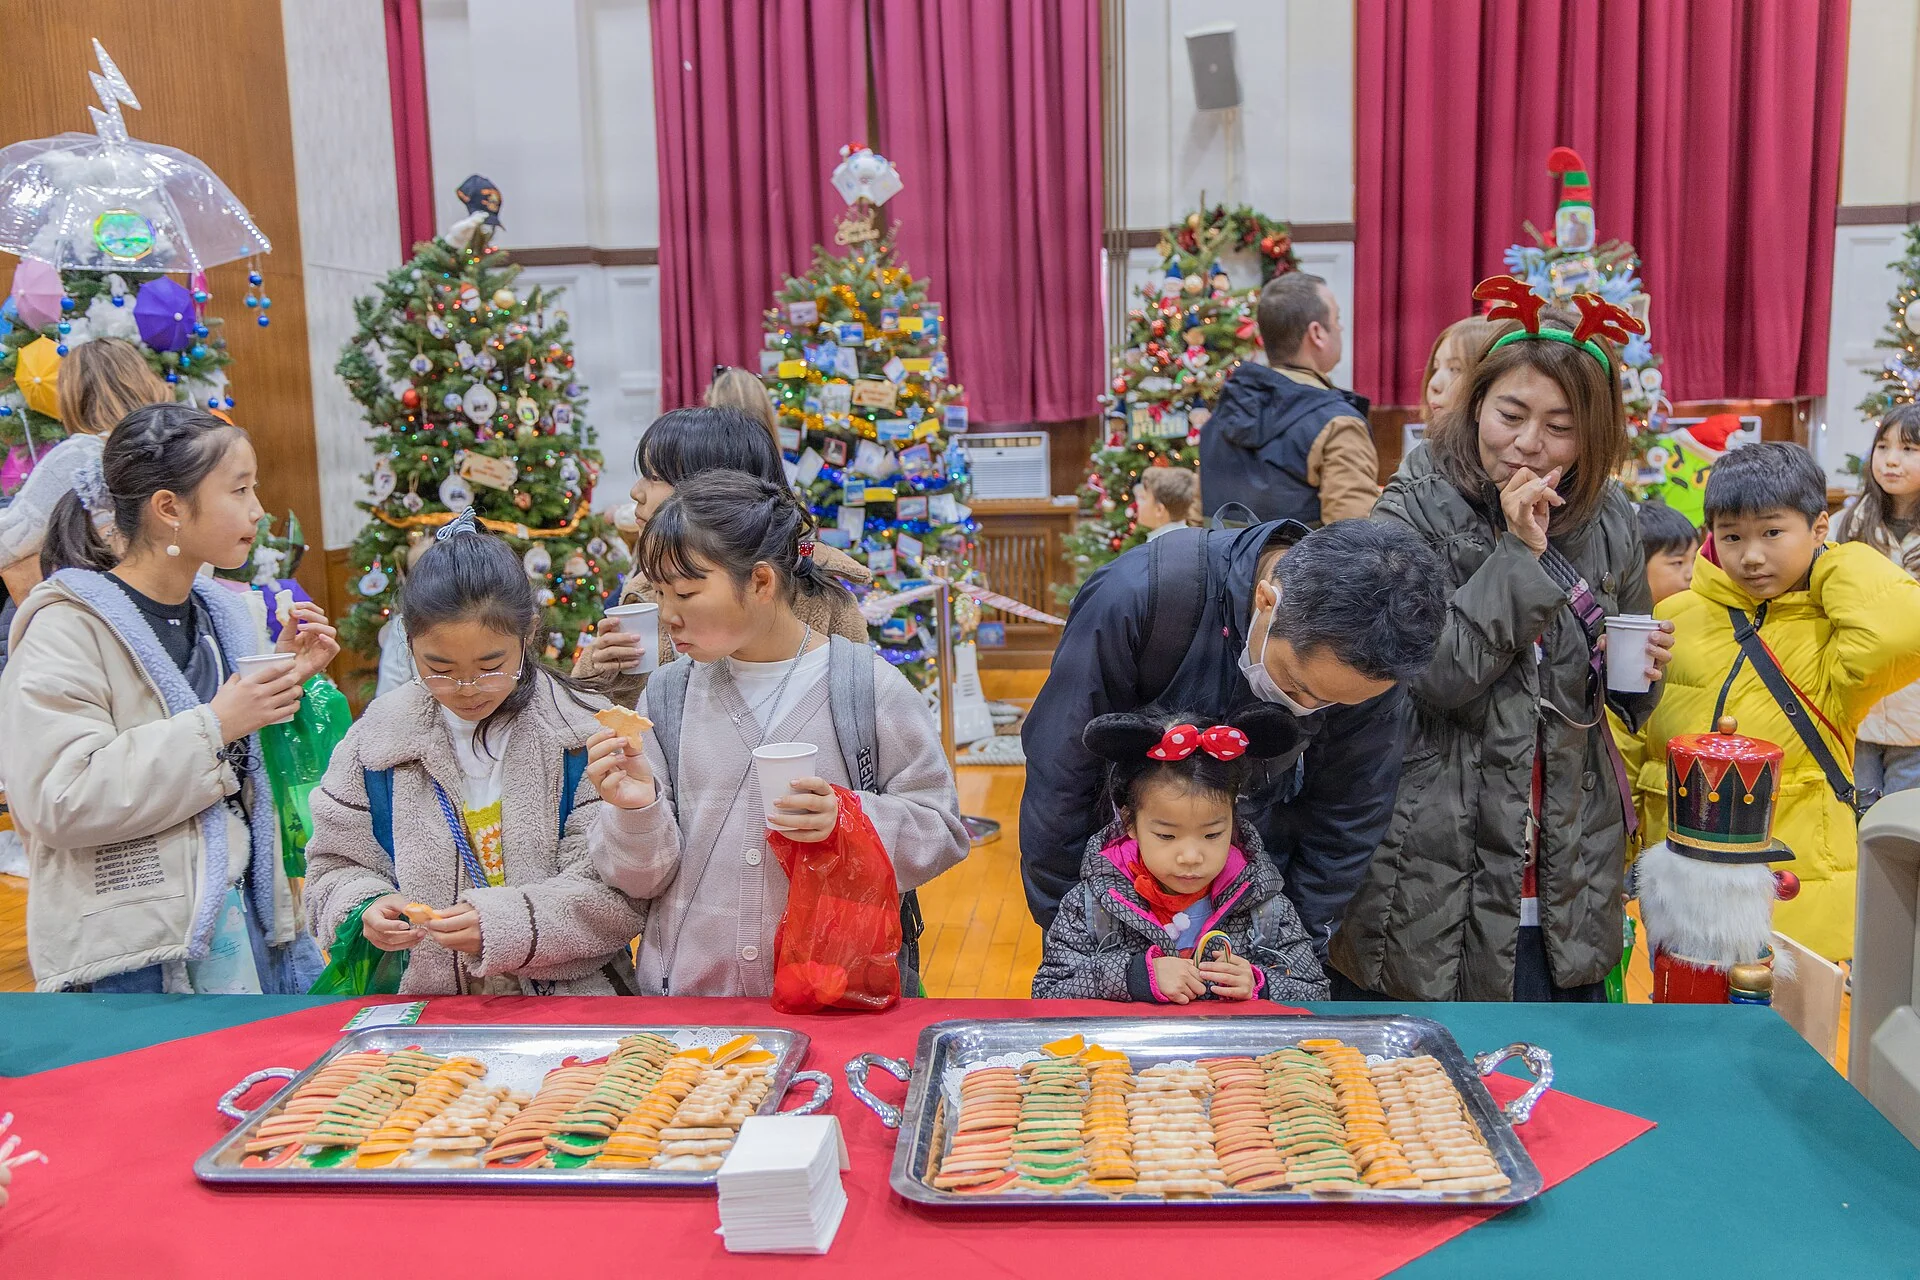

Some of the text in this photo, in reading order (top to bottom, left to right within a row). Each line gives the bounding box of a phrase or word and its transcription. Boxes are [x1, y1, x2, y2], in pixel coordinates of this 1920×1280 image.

[130, 840, 157, 849] DOCTOR
[130, 848, 157, 857] DOCTOR
[132, 855, 159, 864] DOCTOR
[109, 869, 125, 877] NEED
[133, 863, 160, 872] DOCTOR
[136, 870, 163, 879] DOCTOR
[138, 878, 165, 886] DOCTOR
